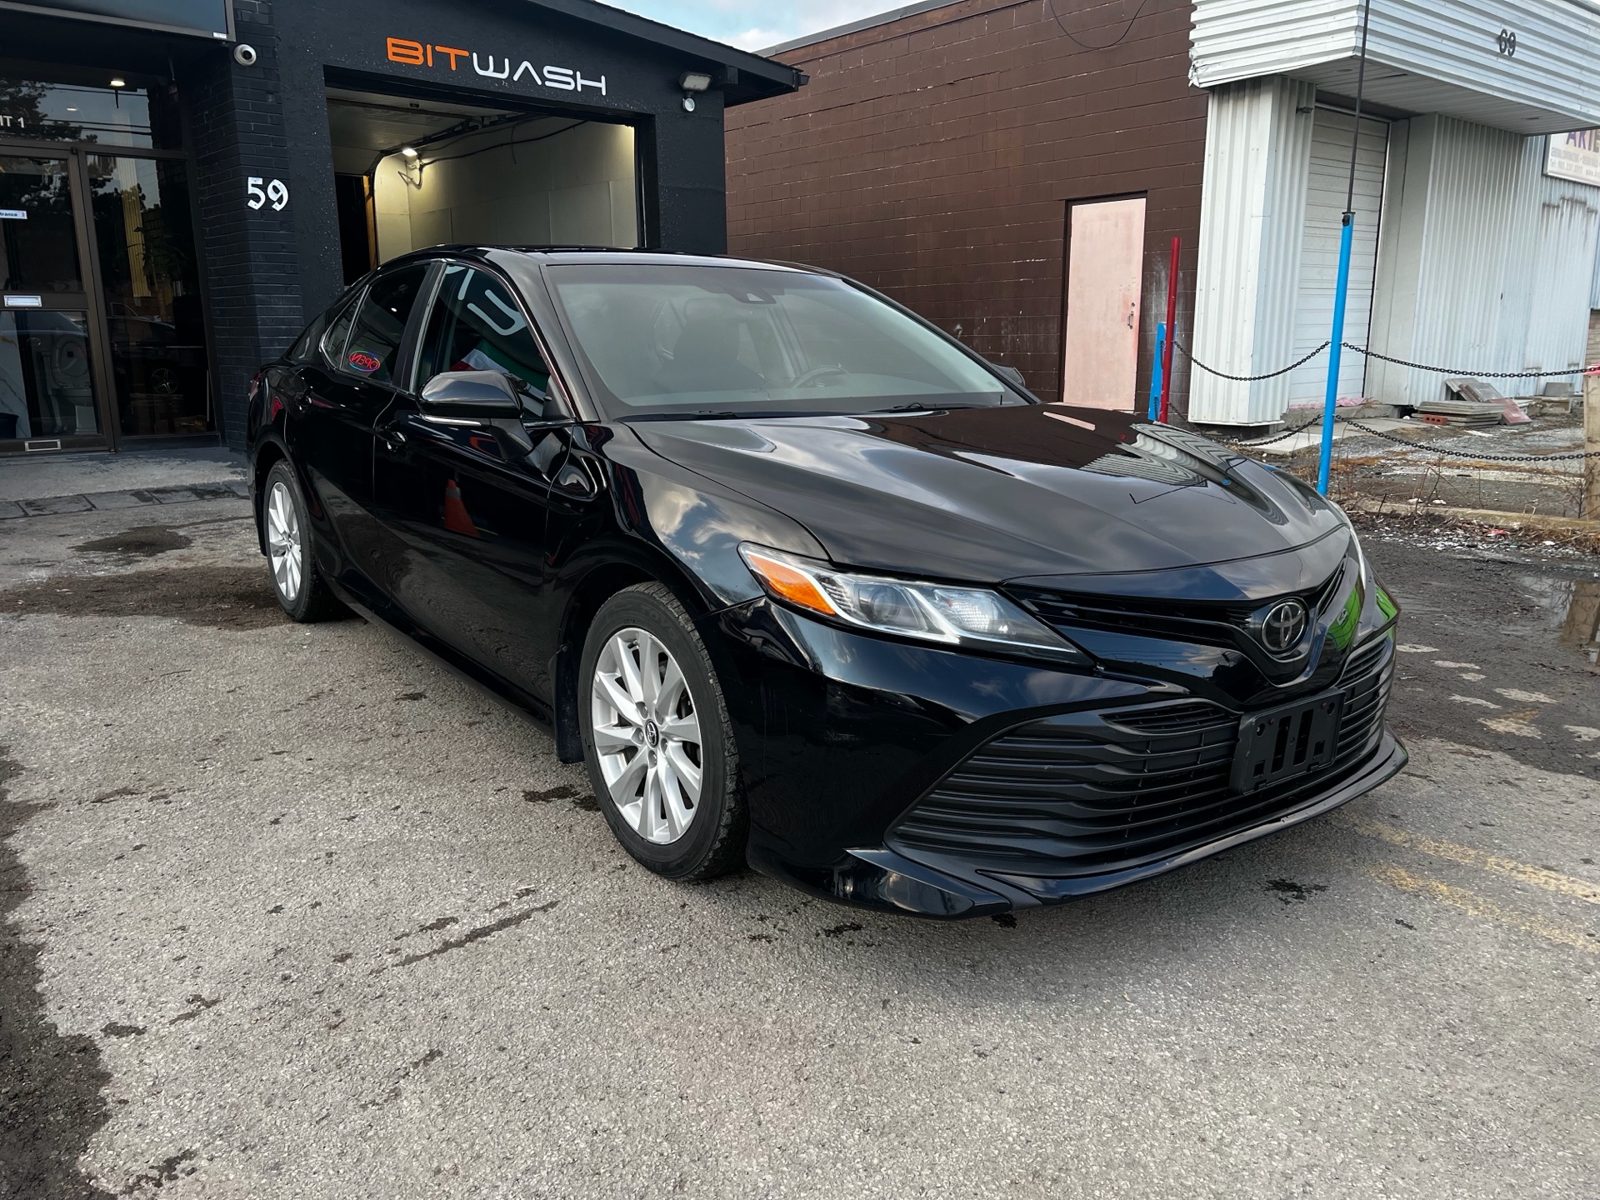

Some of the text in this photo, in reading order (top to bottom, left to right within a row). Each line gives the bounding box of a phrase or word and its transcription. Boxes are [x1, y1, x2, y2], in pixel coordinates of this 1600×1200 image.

[1499, 29, 1517, 57] 69
[17, 117, 25, 128] 1
[247, 176, 289, 212] 59
